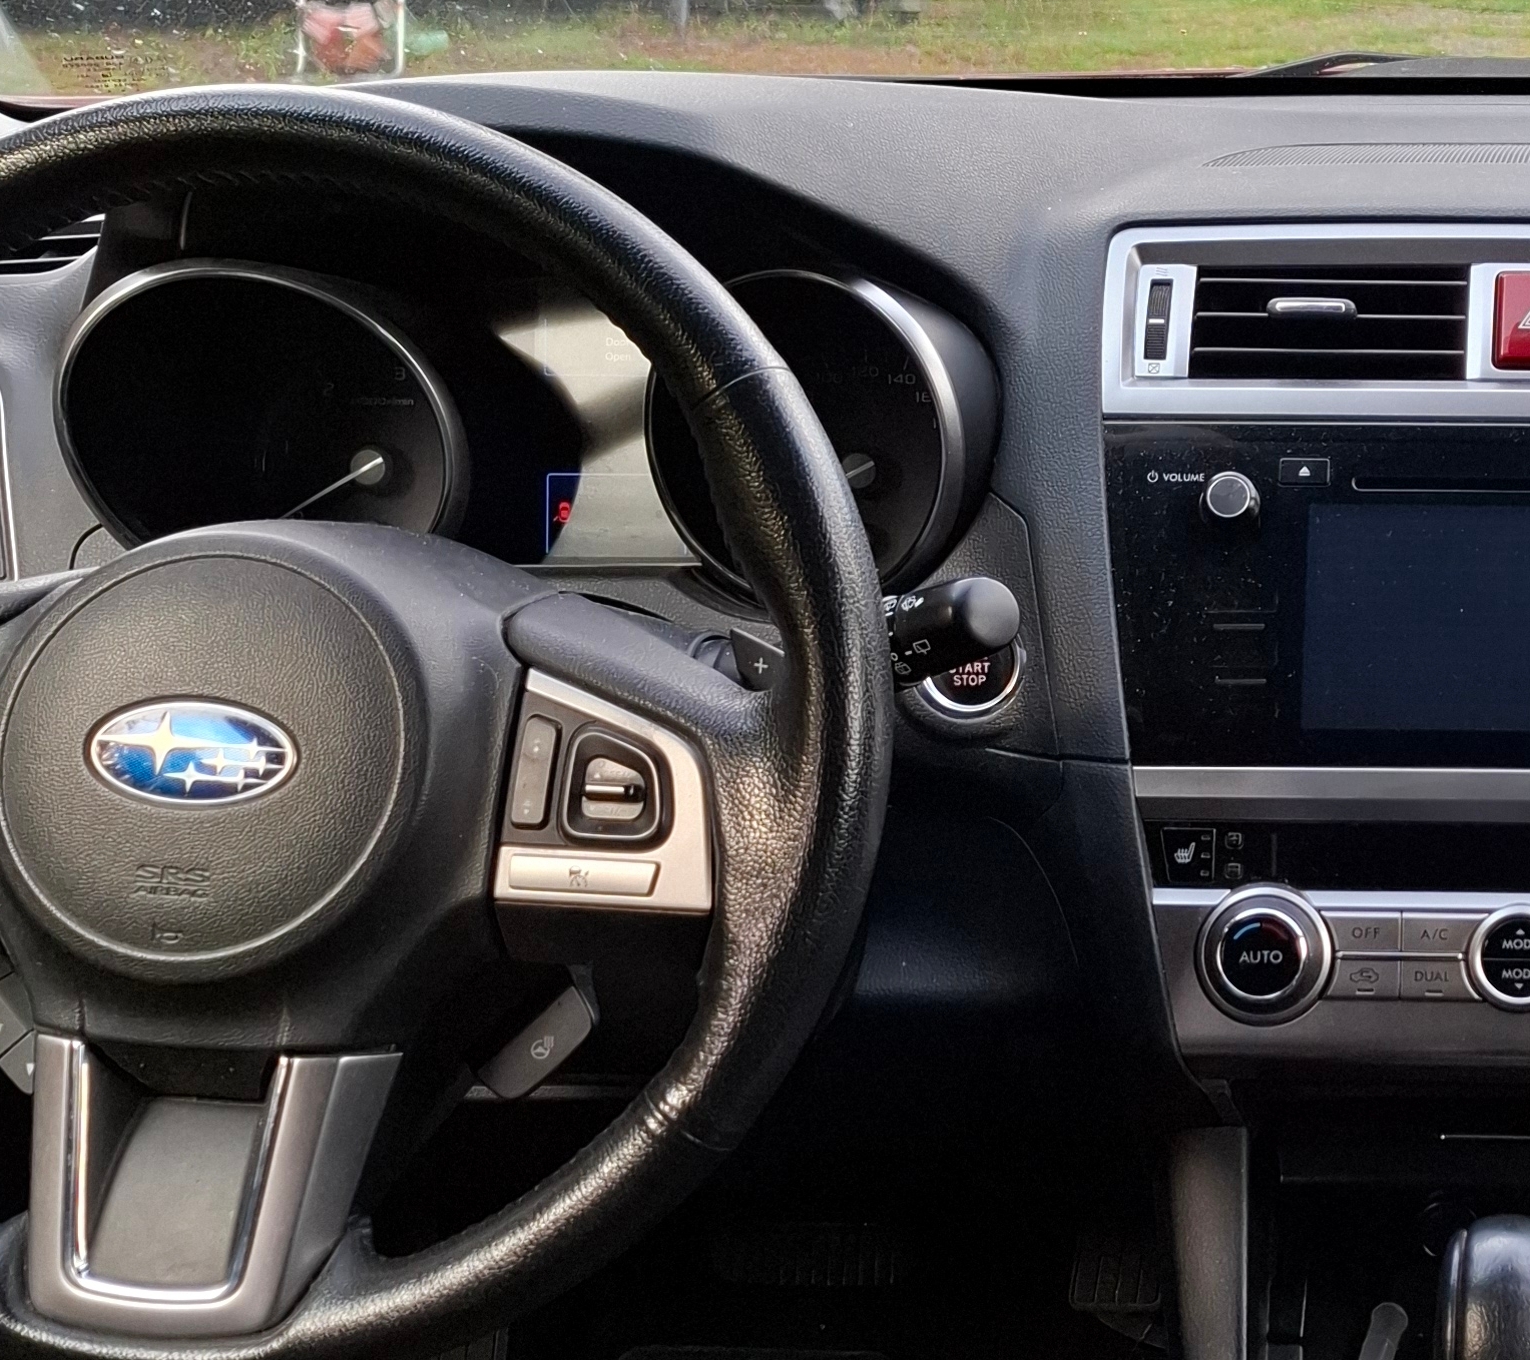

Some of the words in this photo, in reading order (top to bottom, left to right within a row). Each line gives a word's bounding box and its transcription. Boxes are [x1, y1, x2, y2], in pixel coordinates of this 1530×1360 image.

[605, 351, 631, 363] Open
[887, 373, 917, 385] 140
[1162, 473, 1205, 482] VOLUME
[953, 674, 987, 687] STOP
[134, 864, 211, 886] SRS
[132, 885, 211, 900] AIRBAG
[1351, 926, 1381, 939] OFF
[1420, 927, 1449, 941] A/C
[1238, 949, 1284, 965] AUTO
[1413, 970, 1449, 982] DUAL
